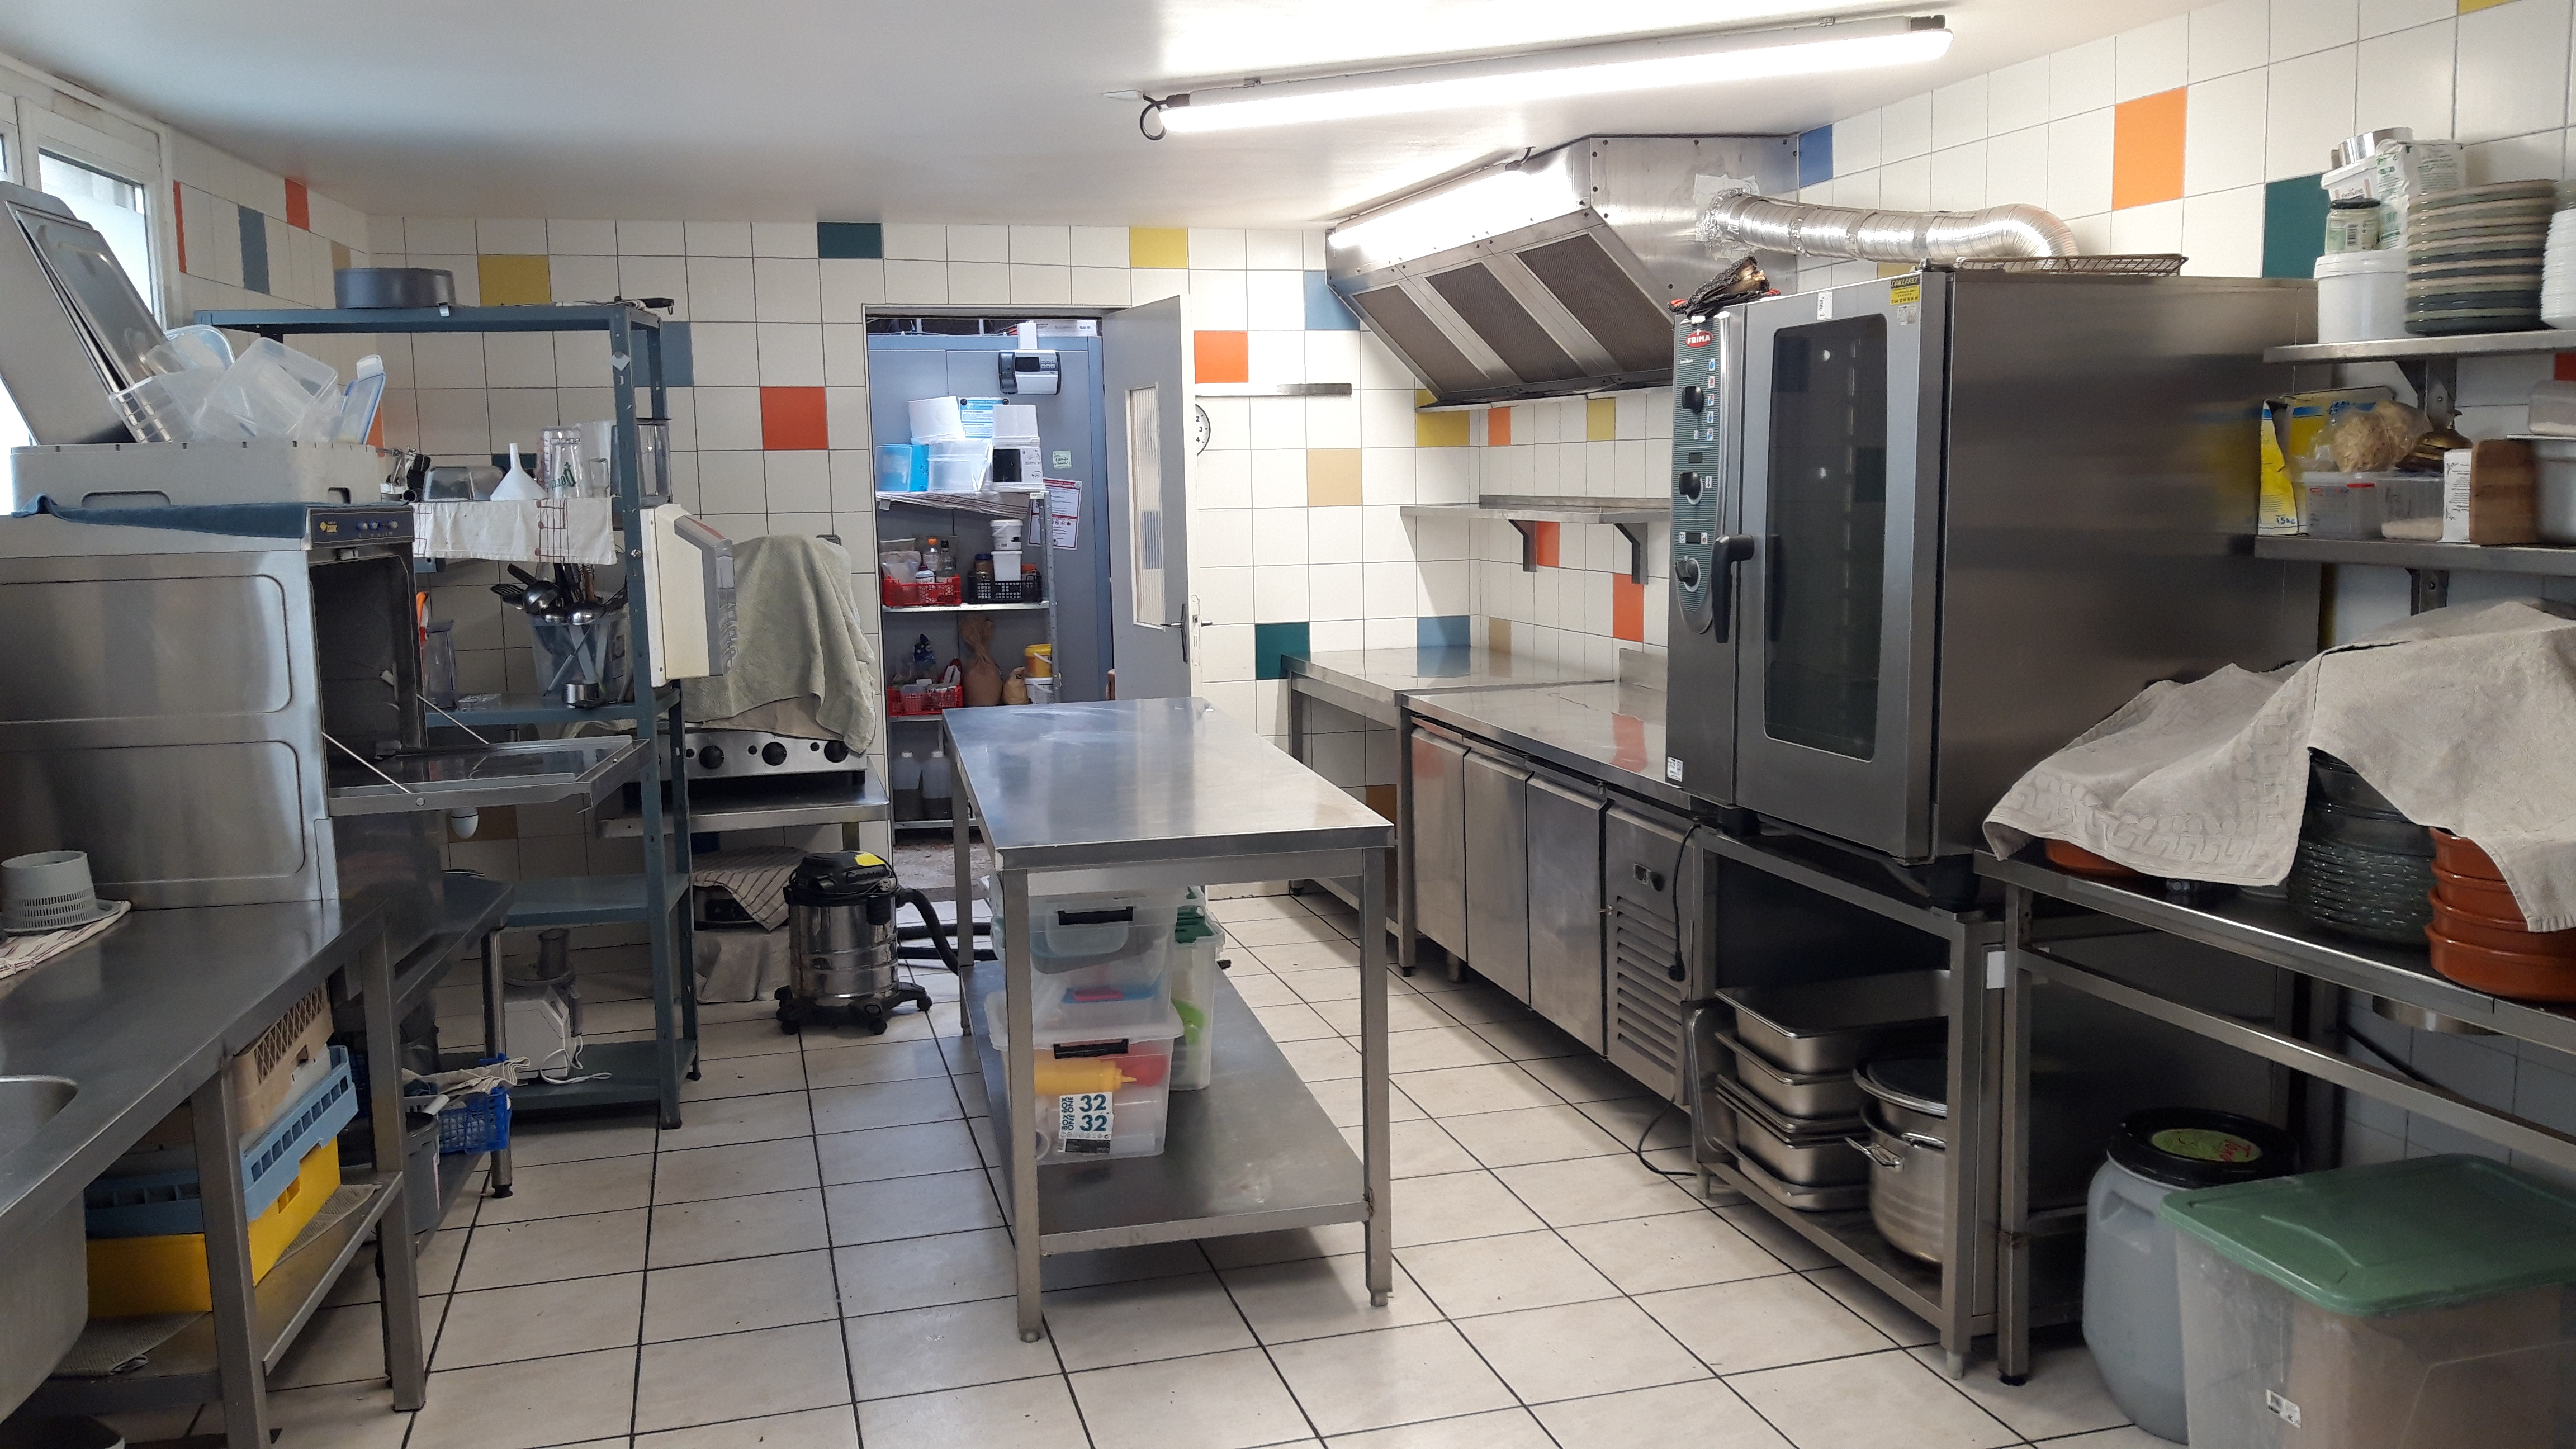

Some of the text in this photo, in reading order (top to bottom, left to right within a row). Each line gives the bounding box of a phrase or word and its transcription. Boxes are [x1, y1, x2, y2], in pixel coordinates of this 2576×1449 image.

[1687, 335, 1711, 344] FRIMA
[1079, 1094, 1106, 1112] 32
[1079, 1114, 1107, 1131] 32
